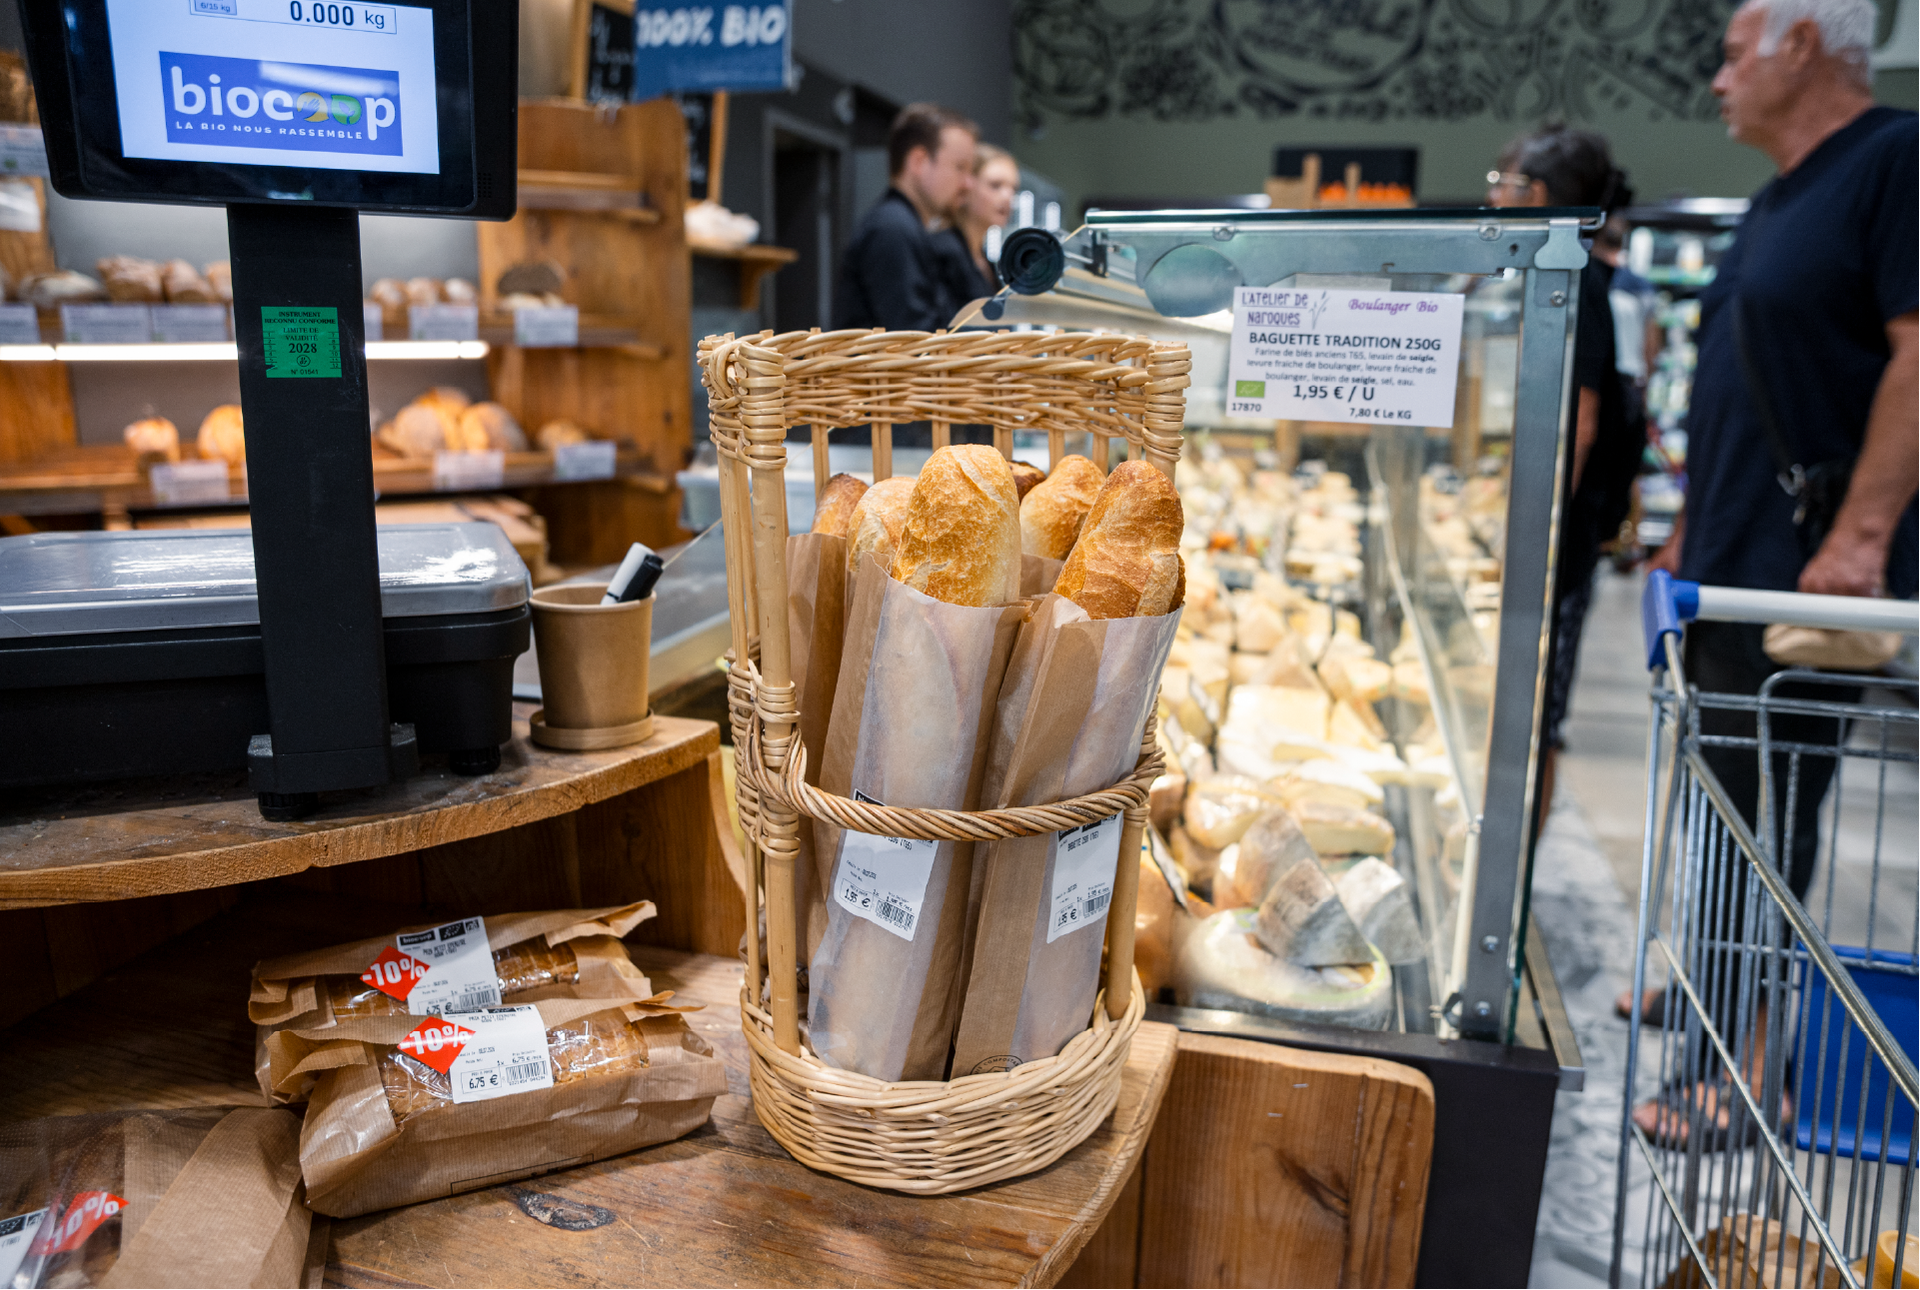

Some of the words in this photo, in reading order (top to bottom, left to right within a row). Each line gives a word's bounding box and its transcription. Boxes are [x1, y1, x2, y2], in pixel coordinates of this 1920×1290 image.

[290, 0, 354, 26] 0.000
[364, 9, 385, 29] kg
[637, 5, 714, 49] 100%
[720, 4, 787, 48] BIO
[171, 66, 396, 141] biocoop
[176, 121, 194, 130] LA
[201, 122, 226, 131] BIO
[233, 125, 272, 134] NOUS
[279, 128, 362, 140] RASSEMBLE
[1348, 298, 1412, 316] Boulanger
[1416, 300, 1438, 313] Bio
[288, 342, 318, 353] 2028
[1249, 332, 1320, 346] BAGUETTE
[1324, 334, 1401, 349] TRADITION
[1405, 337, 1441, 351] 250G
[1255, 347, 1281, 357] Farine
[1283, 348, 1293, 357] de
[1295, 347, 1312, 358] blés
[1315, 350, 1346, 360] anciens
[1368, 351, 1394, 361] levain
[1396, 352, 1407, 361] de
[1247, 359, 1272, 367] levure
[1305, 360, 1316, 369] de
[1317, 360, 1363, 373] boulanger,
[1365, 363, 1392, 372] levure
[1425, 366, 1436, 375] de
[1265, 371, 1310, 383] boulanger,
[1312, 373, 1335, 382] levain
[1338, 374, 1349, 383] de
[1381, 376, 1395, 386] sel,
[1397, 378, 1416, 387] eau.
[1293, 385, 1328, 401] 1,95
[1334, 385, 1344, 400] €
[1347, 385, 1357, 402] /
[1363, 387, 1375, 400] U
[1231, 402, 1262, 412] 17870
[1349, 407, 1370, 418] 7,80
[1374, 408, 1380, 418] €
[1382, 408, 1394, 418] Le
[1397, 409, 1412, 420] KG
[861, 897, 871, 908] €
[1070, 908, 1077, 920] €
[362, 956, 426, 987] -10%
[445, 1002, 453, 1011] €
[400, 1024, 470, 1055] -10%
[469, 1077, 485, 1089] 6.75
[490, 1074, 499, 1086] €
